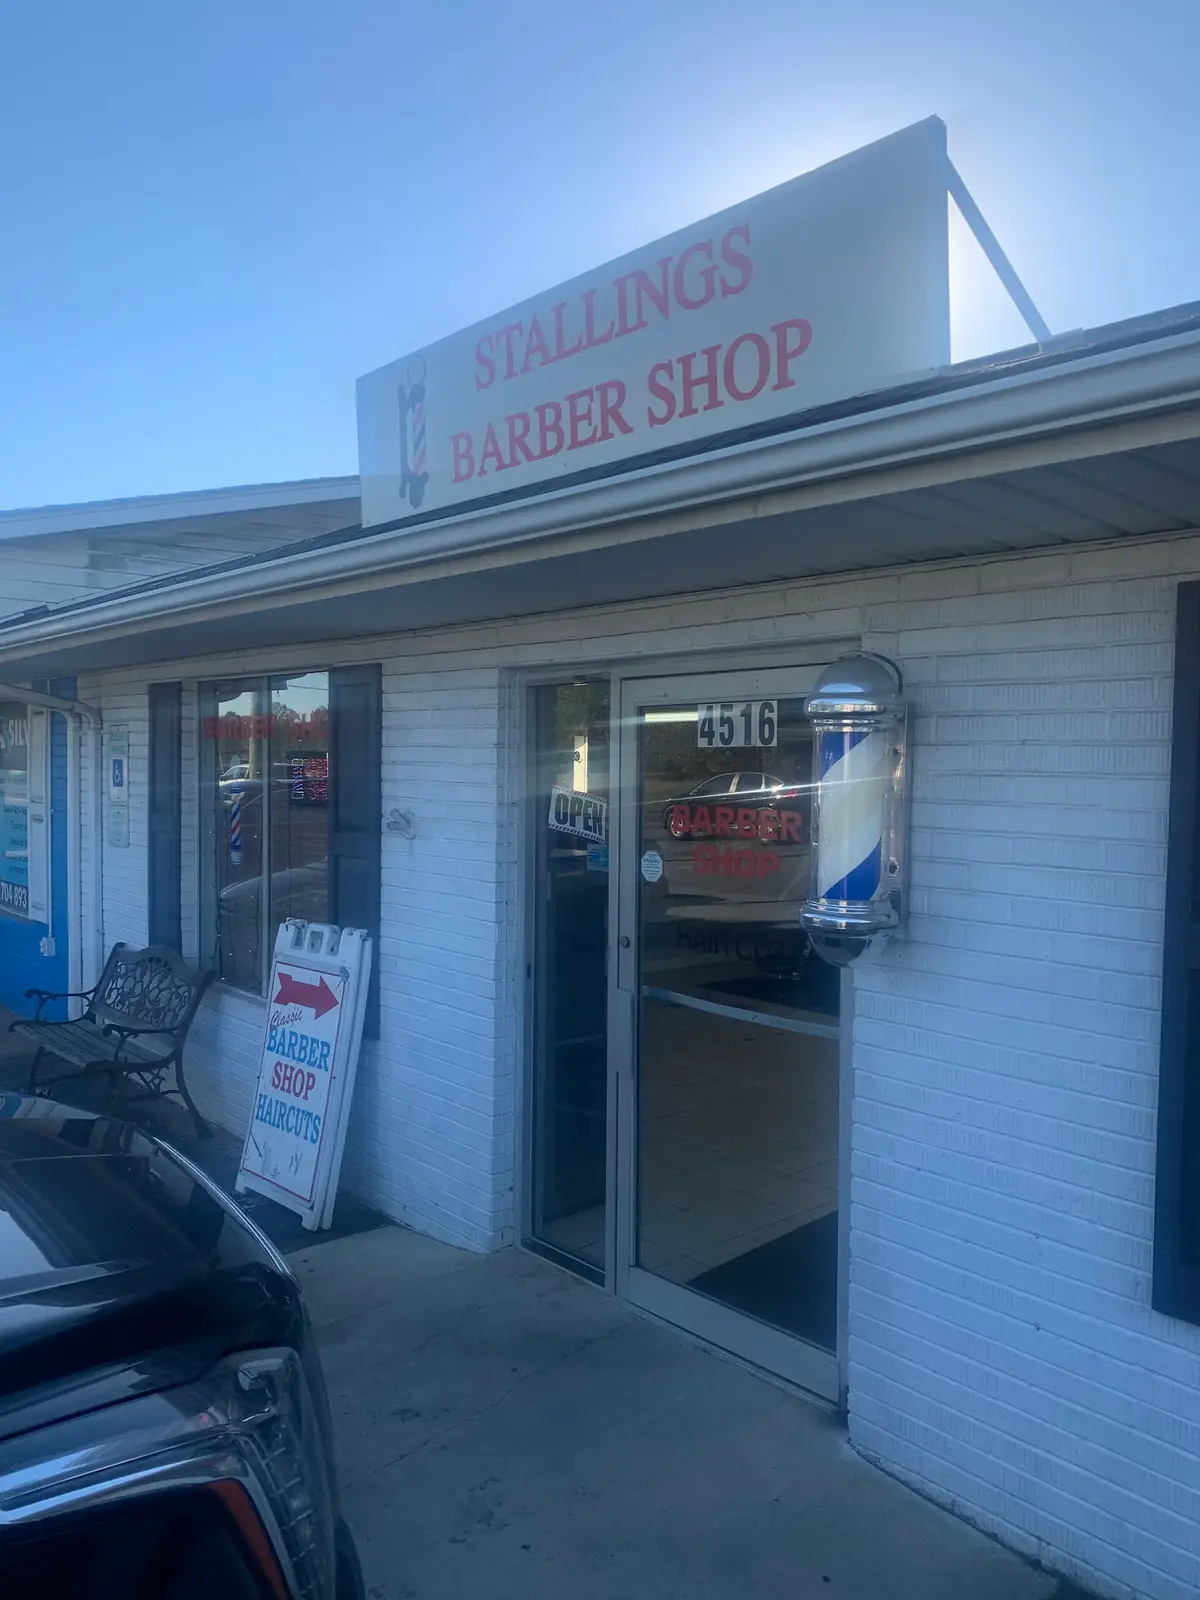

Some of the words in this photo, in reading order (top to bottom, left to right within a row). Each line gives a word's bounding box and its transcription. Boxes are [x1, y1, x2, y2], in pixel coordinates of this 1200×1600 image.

[474, 223, 755, 392] STALLINGS
[449, 379, 634, 484] BARBER
[647, 317, 813, 428] SHOP
[700, 701, 776, 747] 4516
[554, 793, 606, 837] OPEN
[671, 804, 802, 843] BARBER
[691, 844, 781, 880] SHOP
[676, 923, 731, 957] HAIR
[269, 1009, 303, 1031] Classic
[266, 1025, 331, 1072] BARBER
[271, 1060, 316, 1100] SHOP
[255, 1093, 322, 1144] HAIRCUTS
